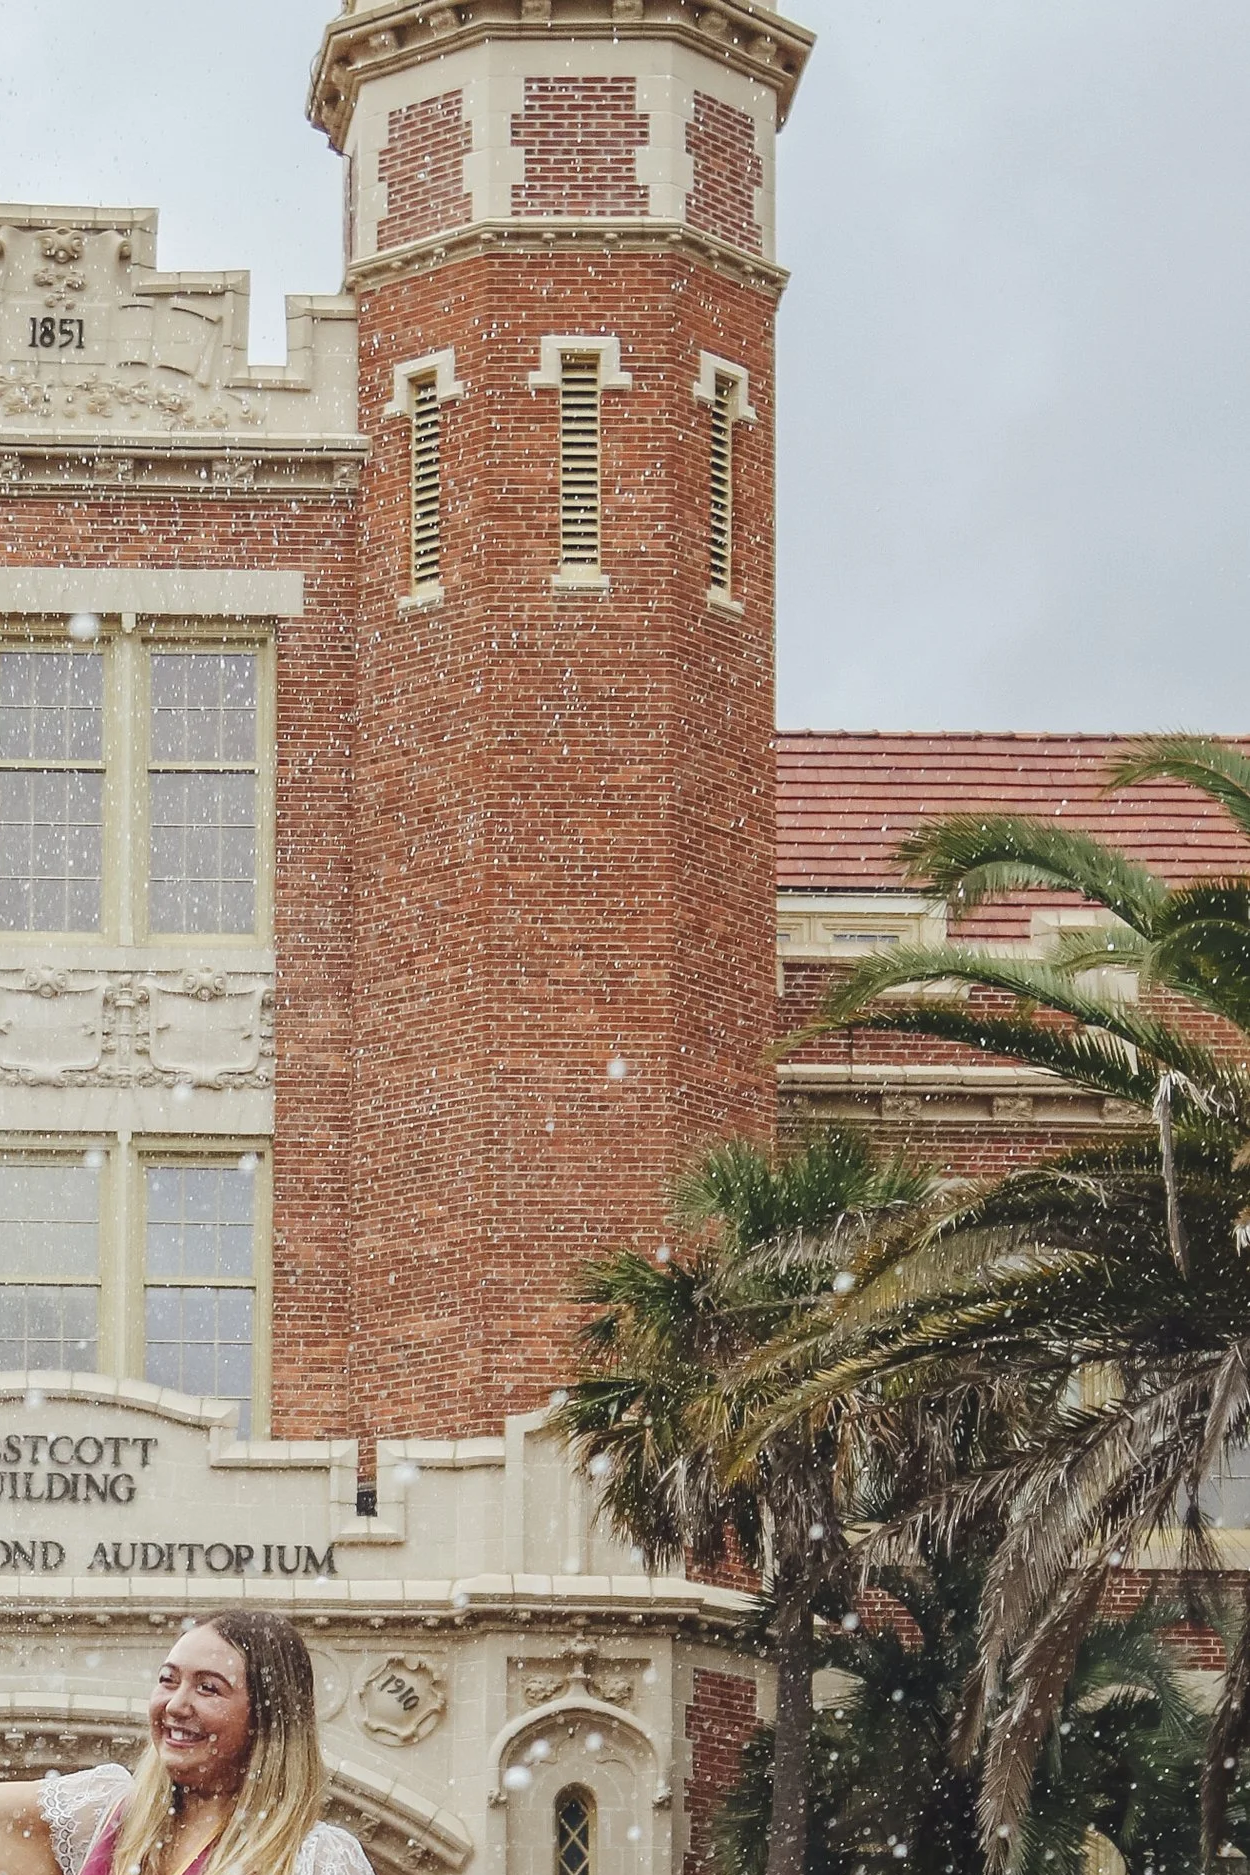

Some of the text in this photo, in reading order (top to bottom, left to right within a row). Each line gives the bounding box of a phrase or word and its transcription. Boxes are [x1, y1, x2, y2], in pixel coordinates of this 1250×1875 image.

[27, 315, 85, 349] 1851
[86, 1541, 338, 1576] AUDITORIUM
[378, 1674, 421, 1711] 1910
